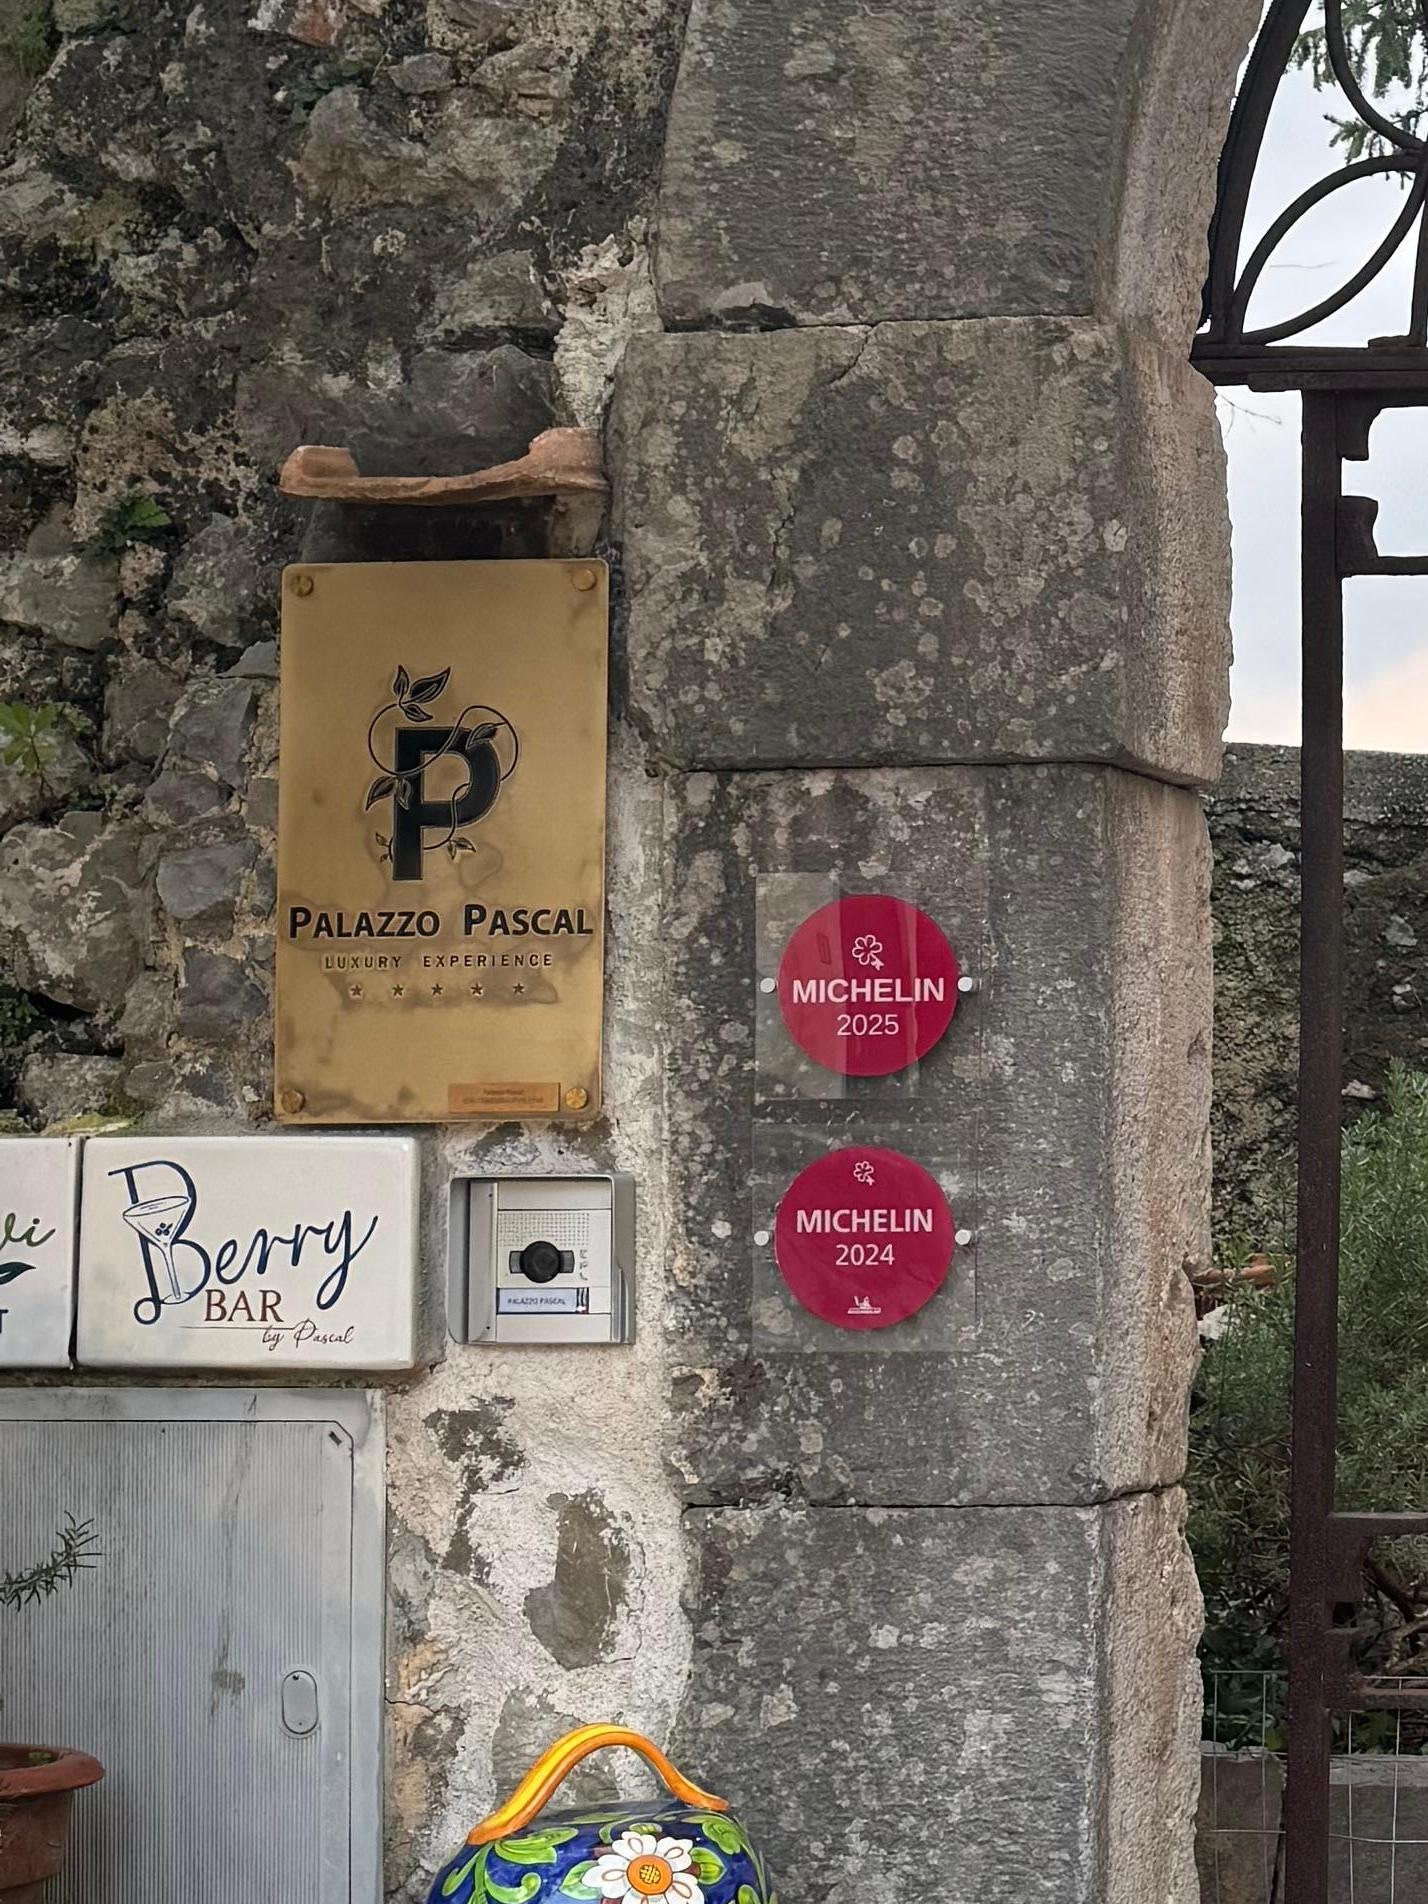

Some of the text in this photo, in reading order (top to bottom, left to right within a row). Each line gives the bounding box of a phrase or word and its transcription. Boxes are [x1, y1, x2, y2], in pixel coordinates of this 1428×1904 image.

[289, 903, 594, 938] PALAZZO PASCAL
[325, 953, 553, 969] LUXURY EXPERIENCE
[792, 976, 945, 1004] MICHELIN
[836, 1014, 900, 1036] 2025
[796, 1208, 933, 1234] MICHELIN
[108, 1159, 379, 1325] Berry
[835, 1243, 895, 1266] 2024
[204, 1289, 284, 1323] BAR
[262, 1318, 354, 1351] by Pascal
